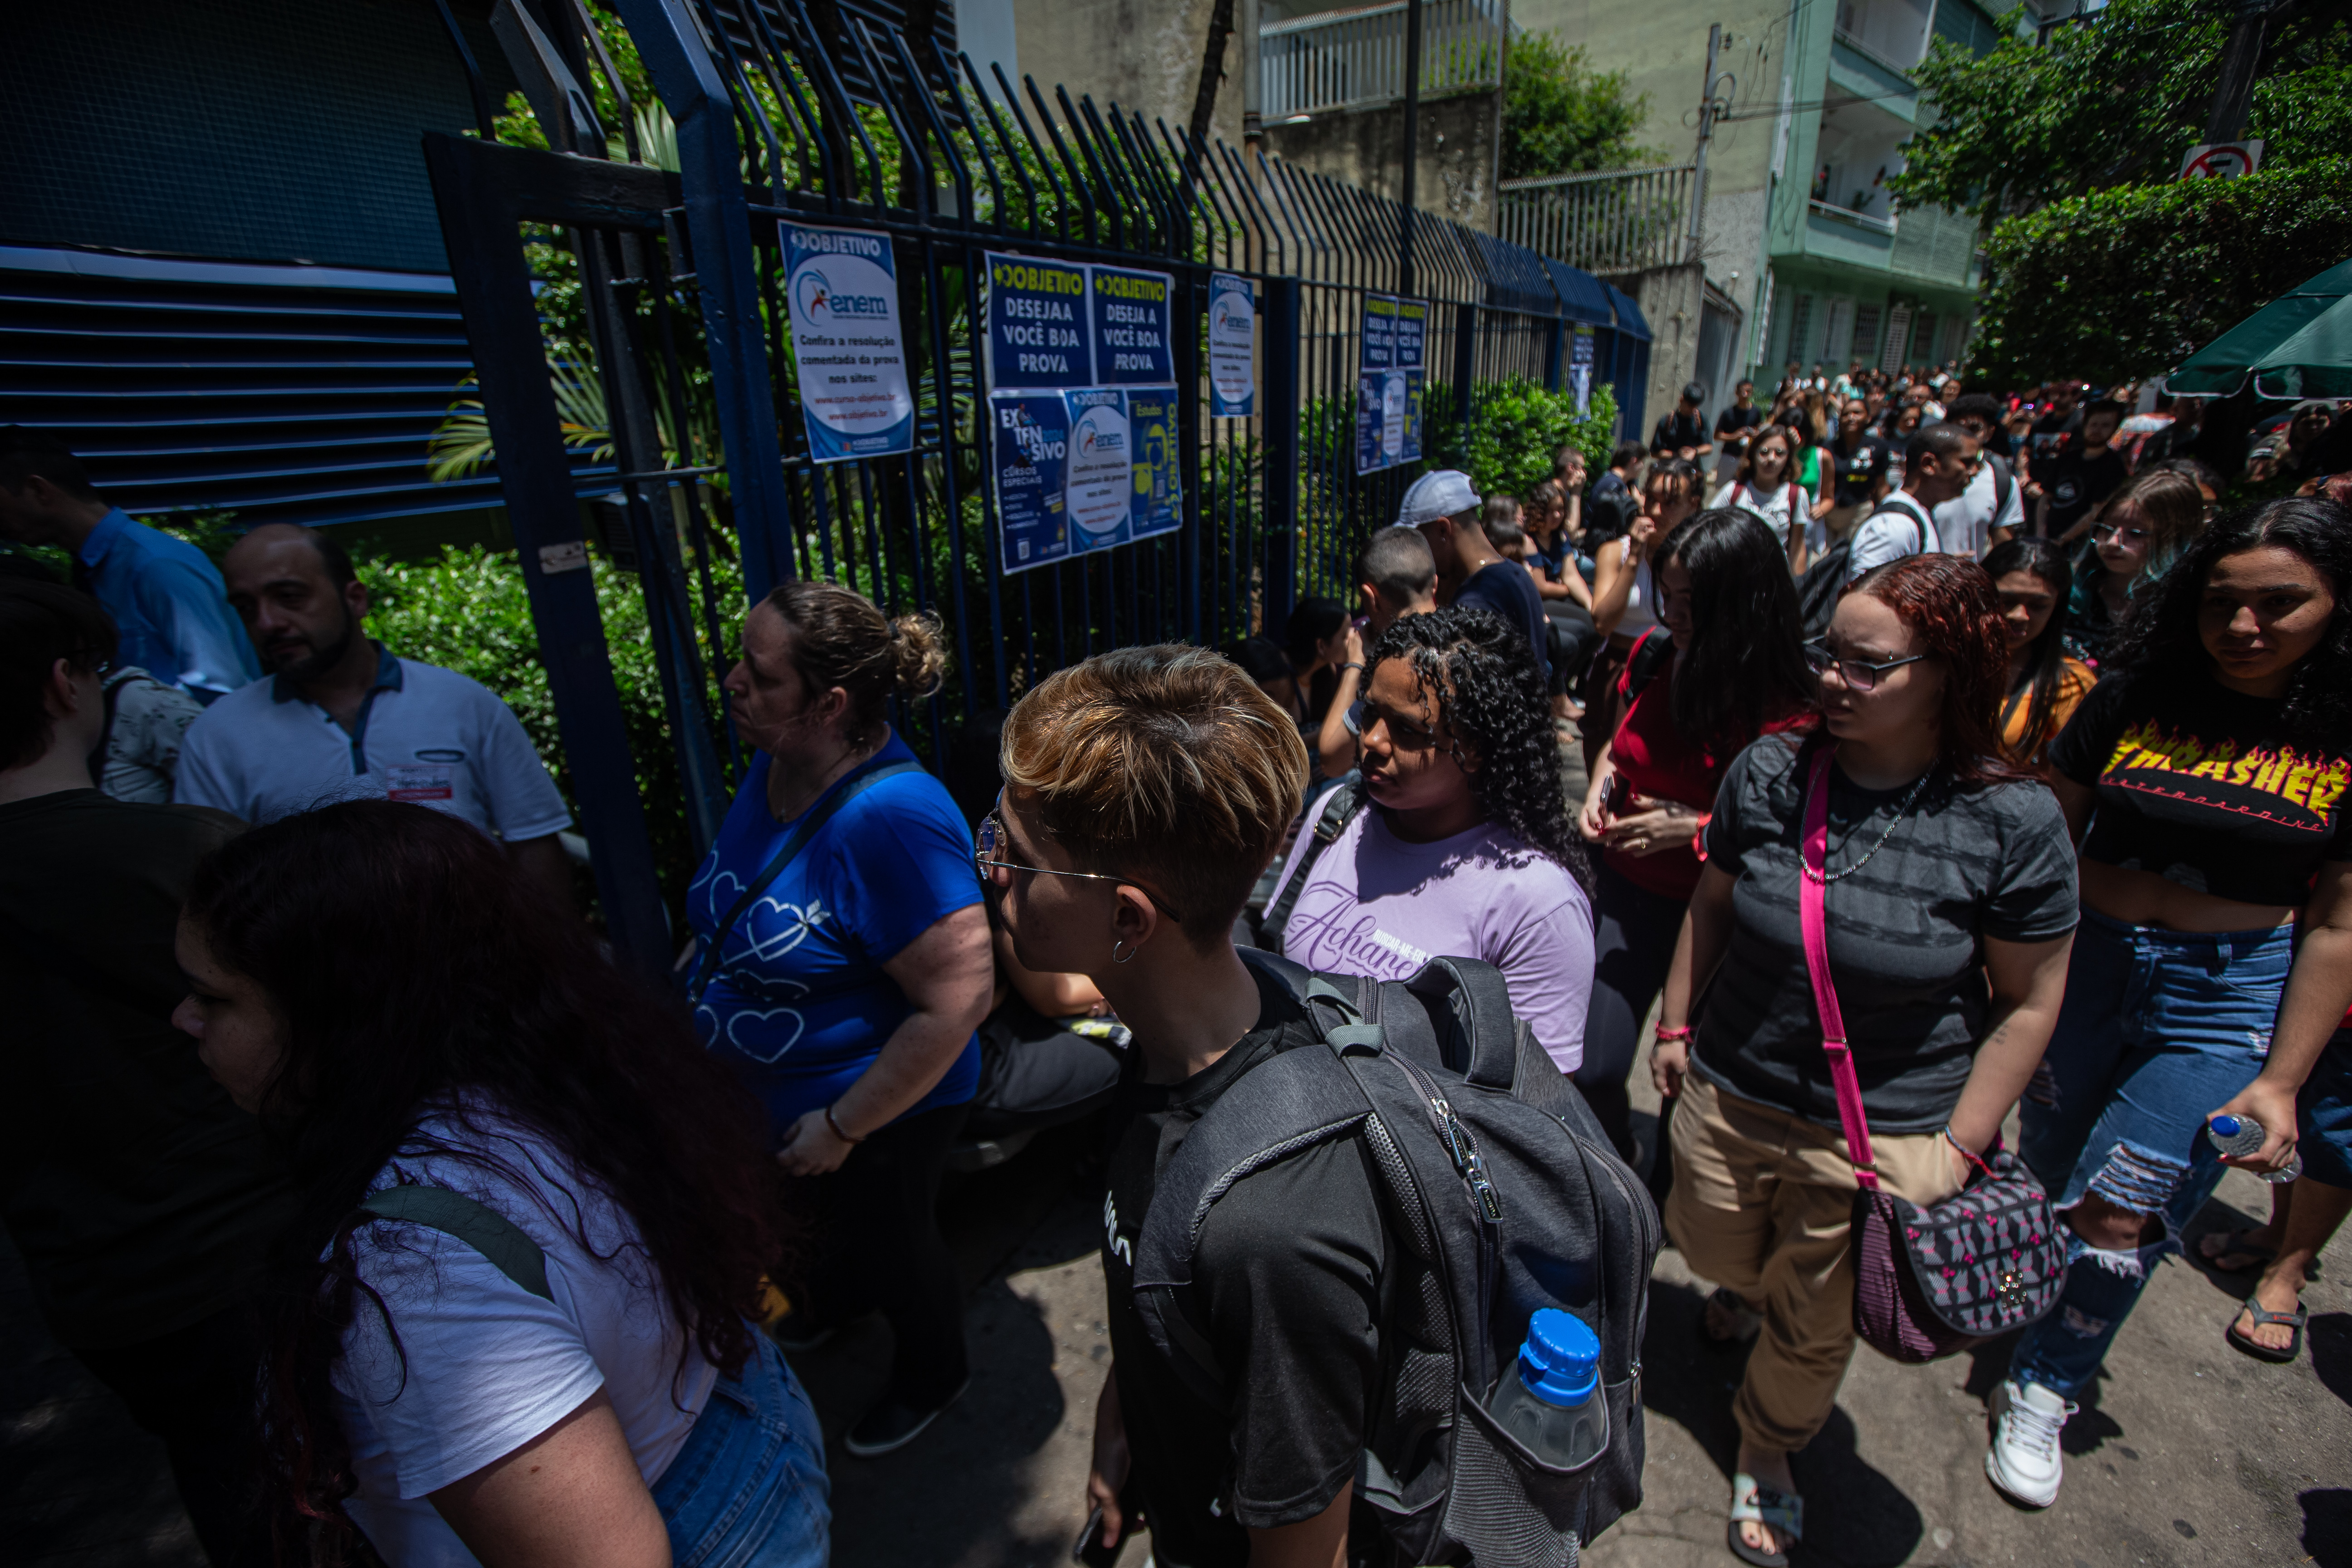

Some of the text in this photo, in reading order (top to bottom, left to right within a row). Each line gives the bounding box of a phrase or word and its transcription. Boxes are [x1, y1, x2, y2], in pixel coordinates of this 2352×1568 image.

[807, 233, 881, 257] OBJETIVO
[830, 295, 888, 314] enem
[1106, 304, 1156, 325] DESEJA A
[799, 334, 835, 345] Confira
[848, 336, 895, 348] resolução
[1003, 321, 1080, 347] VOCÊ BOA
[1103, 324, 1161, 348] VOCÊ BOA
[801, 354, 898, 366] comentada da prova
[1019, 353, 1068, 373] PROVA
[1115, 353, 1154, 371] PROVA
[1031, 441, 1066, 462] SIVO
[1167, 403, 1177, 490] OBJETIVO
[2099, 718, 2351, 827] THRASHER
